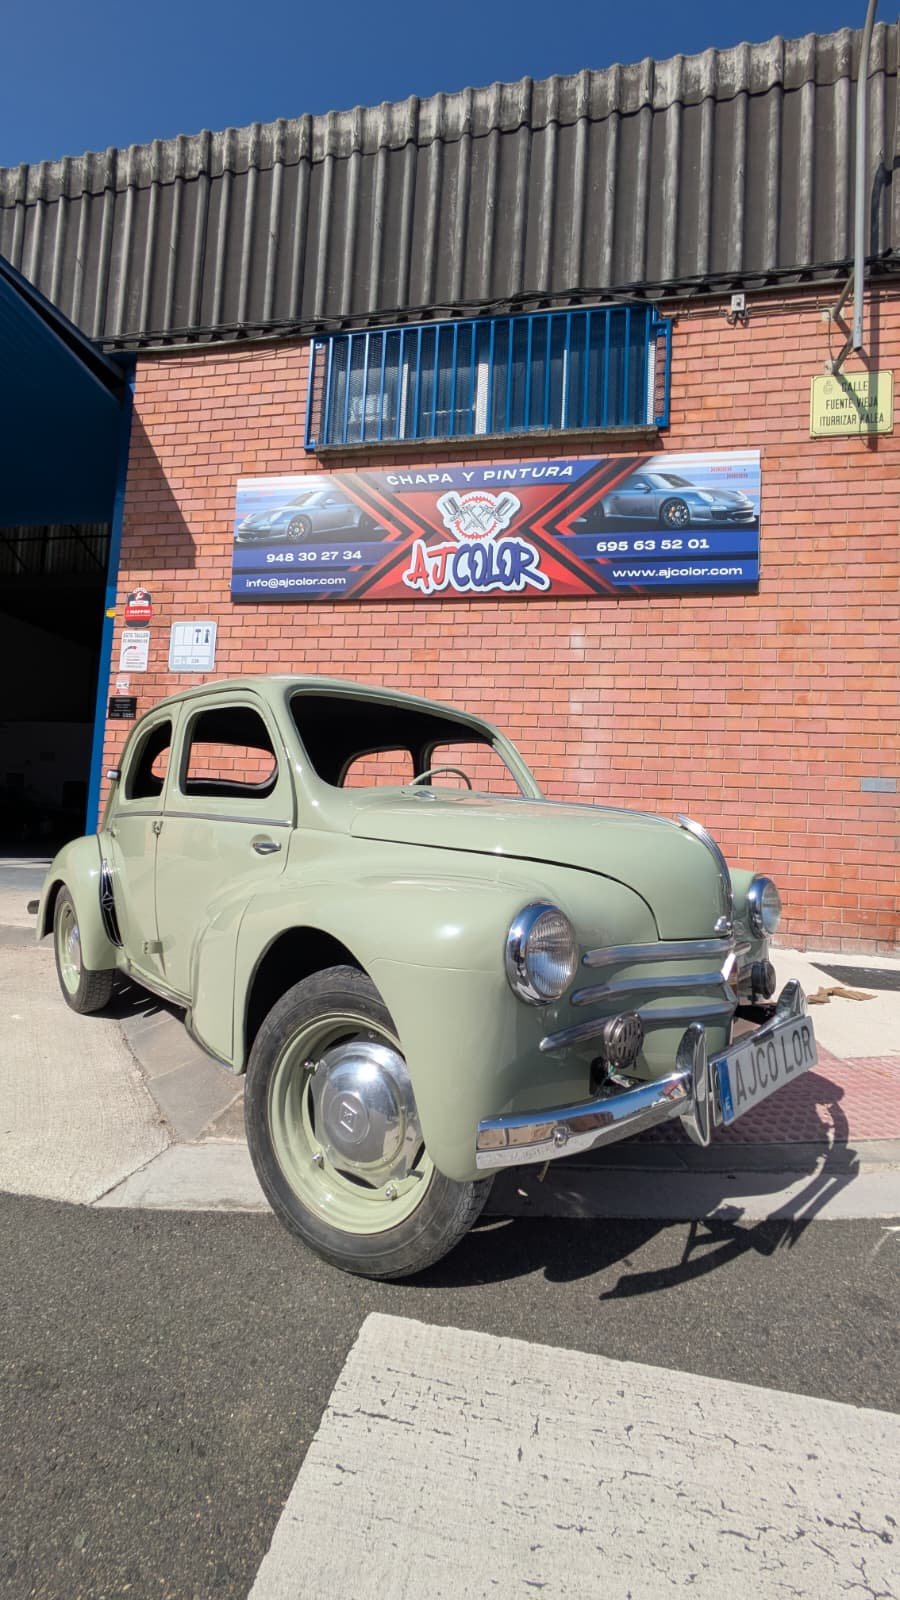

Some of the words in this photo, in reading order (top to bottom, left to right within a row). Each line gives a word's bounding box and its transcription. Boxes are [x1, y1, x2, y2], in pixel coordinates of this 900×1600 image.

[842, 380, 868, 393] CALLE
[825, 398, 853, 410] FUENTE
[857, 396, 879, 409] VIEJA
[819, 414, 857, 427] ITURRIZAR
[860, 412, 884, 425] KALEA
[386, 472, 453, 486] CHAPA
[463, 471, 475, 482] Y
[483, 465, 574, 481] PINTURA
[596, 541, 629, 552] 695
[633, 540, 656, 551] 63
[660, 539, 683, 550] 52
[687, 538, 710, 549] 01
[266, 552, 294, 563] 948
[298, 551, 317, 562] 30
[322, 551, 340, 561] 27
[342, 550, 362, 560] 34
[612, 566, 743, 579] www.ajcolor.com
[245, 575, 347, 589] info@ajcolor.com
